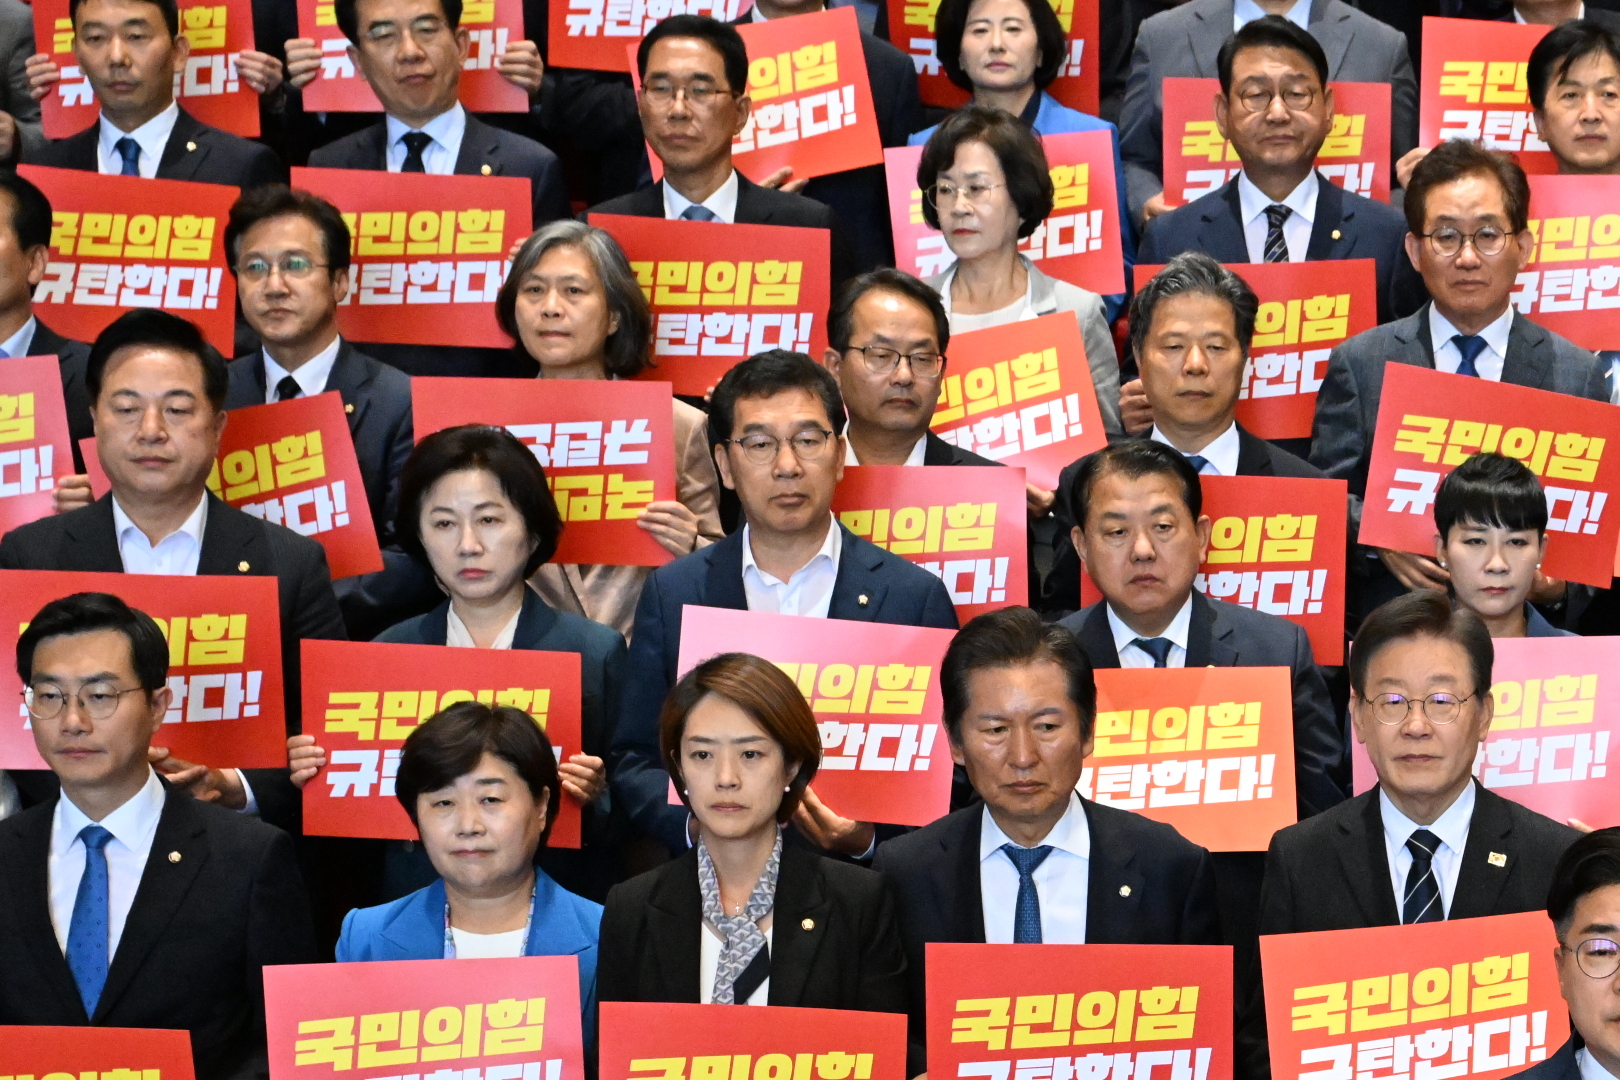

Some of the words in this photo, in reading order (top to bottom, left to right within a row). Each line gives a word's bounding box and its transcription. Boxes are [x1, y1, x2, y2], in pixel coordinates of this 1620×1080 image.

[58, 53, 242, 107] 규다!
[749, 41, 838, 101] 의힘
[1440, 61, 1529, 104] 국민
[732, 84, 857, 154] 한다!
[1182, 114, 1366, 163] 국힘
[52, 212, 215, 261] 국민의힘
[914, 209, 1103, 278] 규다!
[32, 262, 222, 309] 규탄한다!
[652, 312, 813, 356] 탄한다!
[1252, 295, 1350, 347] 의힘
[940, 394, 1082, 461] 한다!
[207, 430, 325, 501] 의힘
[840, 502, 997, 555] 민의힘
[1386, 468, 1609, 536] 규다!
[1208, 514, 1317, 565] 의힘
[1195, 569, 1328, 615] 한다!
[793, 663, 931, 714] 의힘
[1490, 674, 1597, 731] 의힘
[818, 721, 937, 771] 한다!
[1094, 702, 1261, 758] 민의힘
[1475, 731, 1609, 788] 한다!
[950, 986, 1200, 1051] 국민의힘
[1292, 952, 1530, 1035] 국민의힘
[295, 998, 546, 1071] 국민의힘
